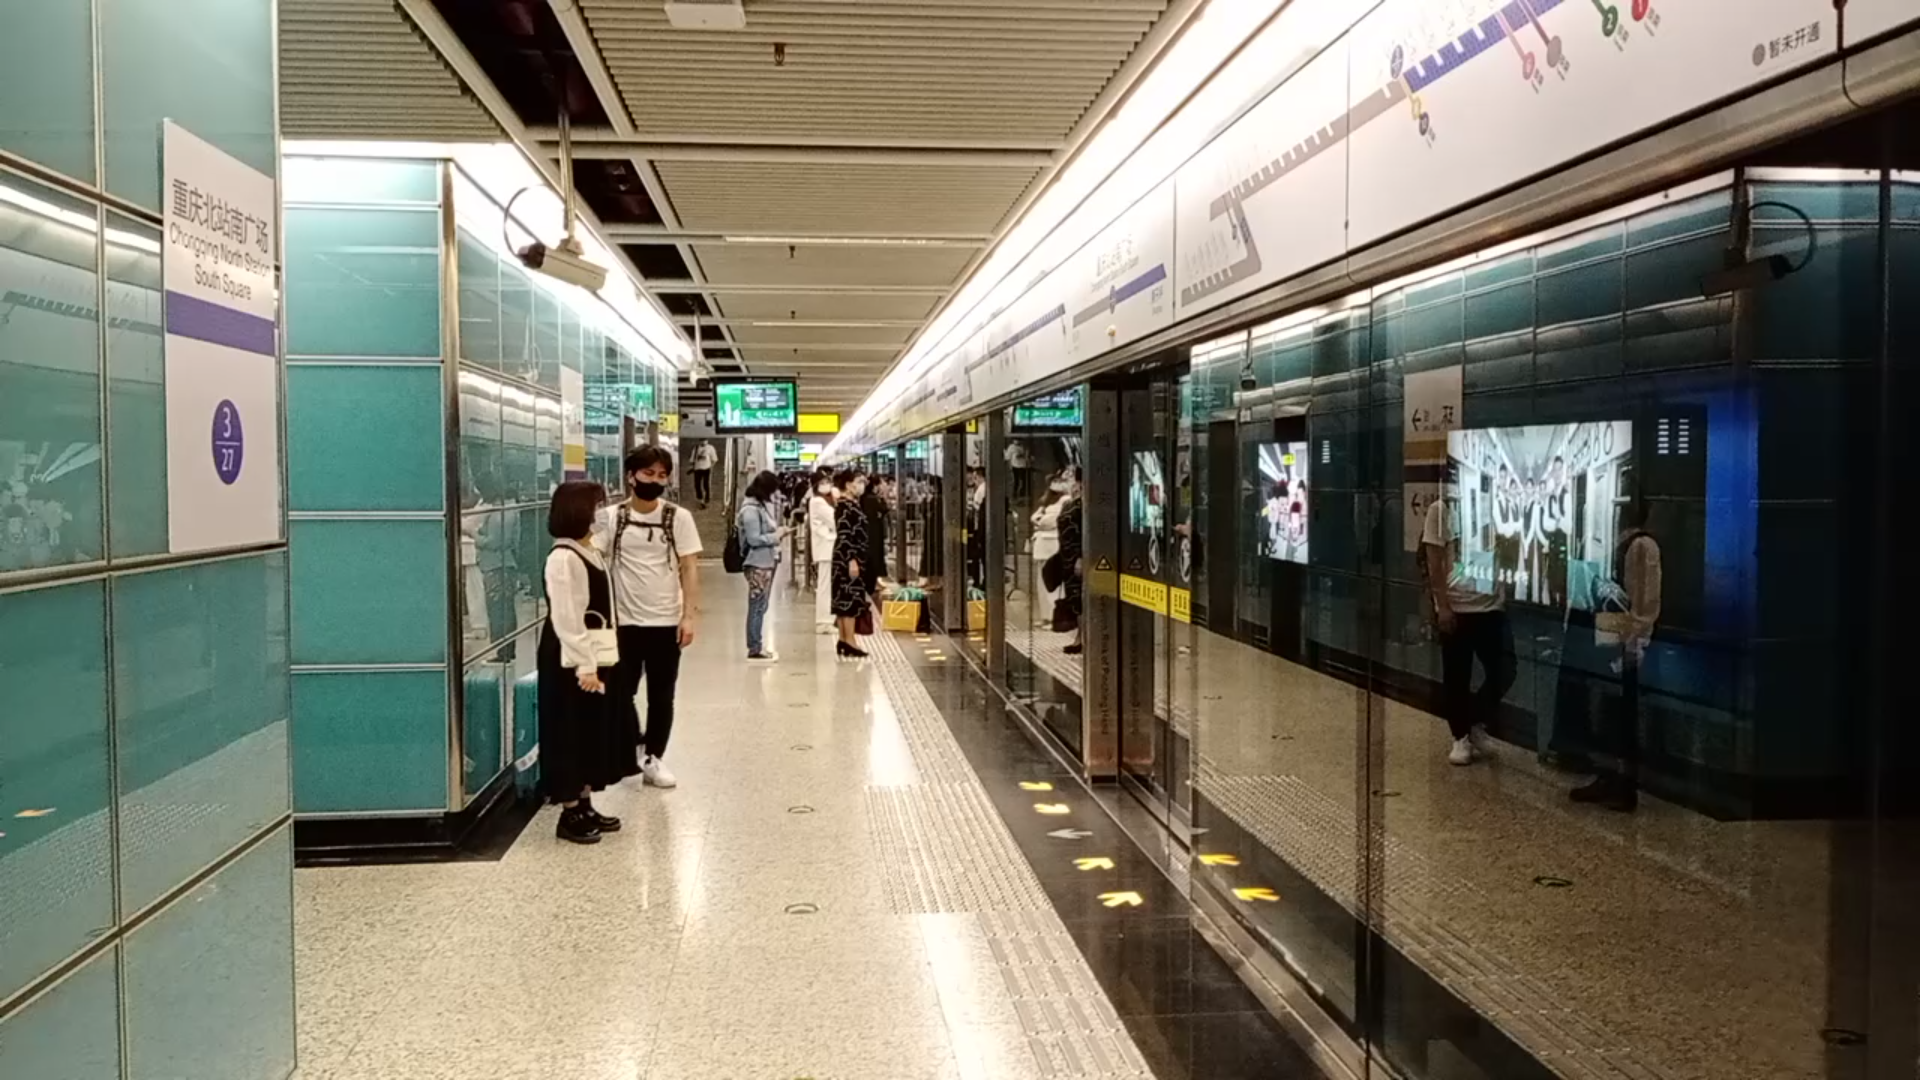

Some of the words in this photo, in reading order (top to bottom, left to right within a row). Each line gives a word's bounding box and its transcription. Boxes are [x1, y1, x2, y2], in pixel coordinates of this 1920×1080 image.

[1606, 13, 1614, 29] 2
[1769, 20, 1820, 59] 暂未开通
[172, 178, 268, 254] 重庆北站南广场
[169, 221, 219, 265] Chongqing
[220, 242, 243, 269] North
[244, 251, 271, 277] Station
[194, 263, 221, 291] South
[222, 272, 251, 300] Square
[223, 406, 232, 438] 3
[221, 448, 234, 471] 27
